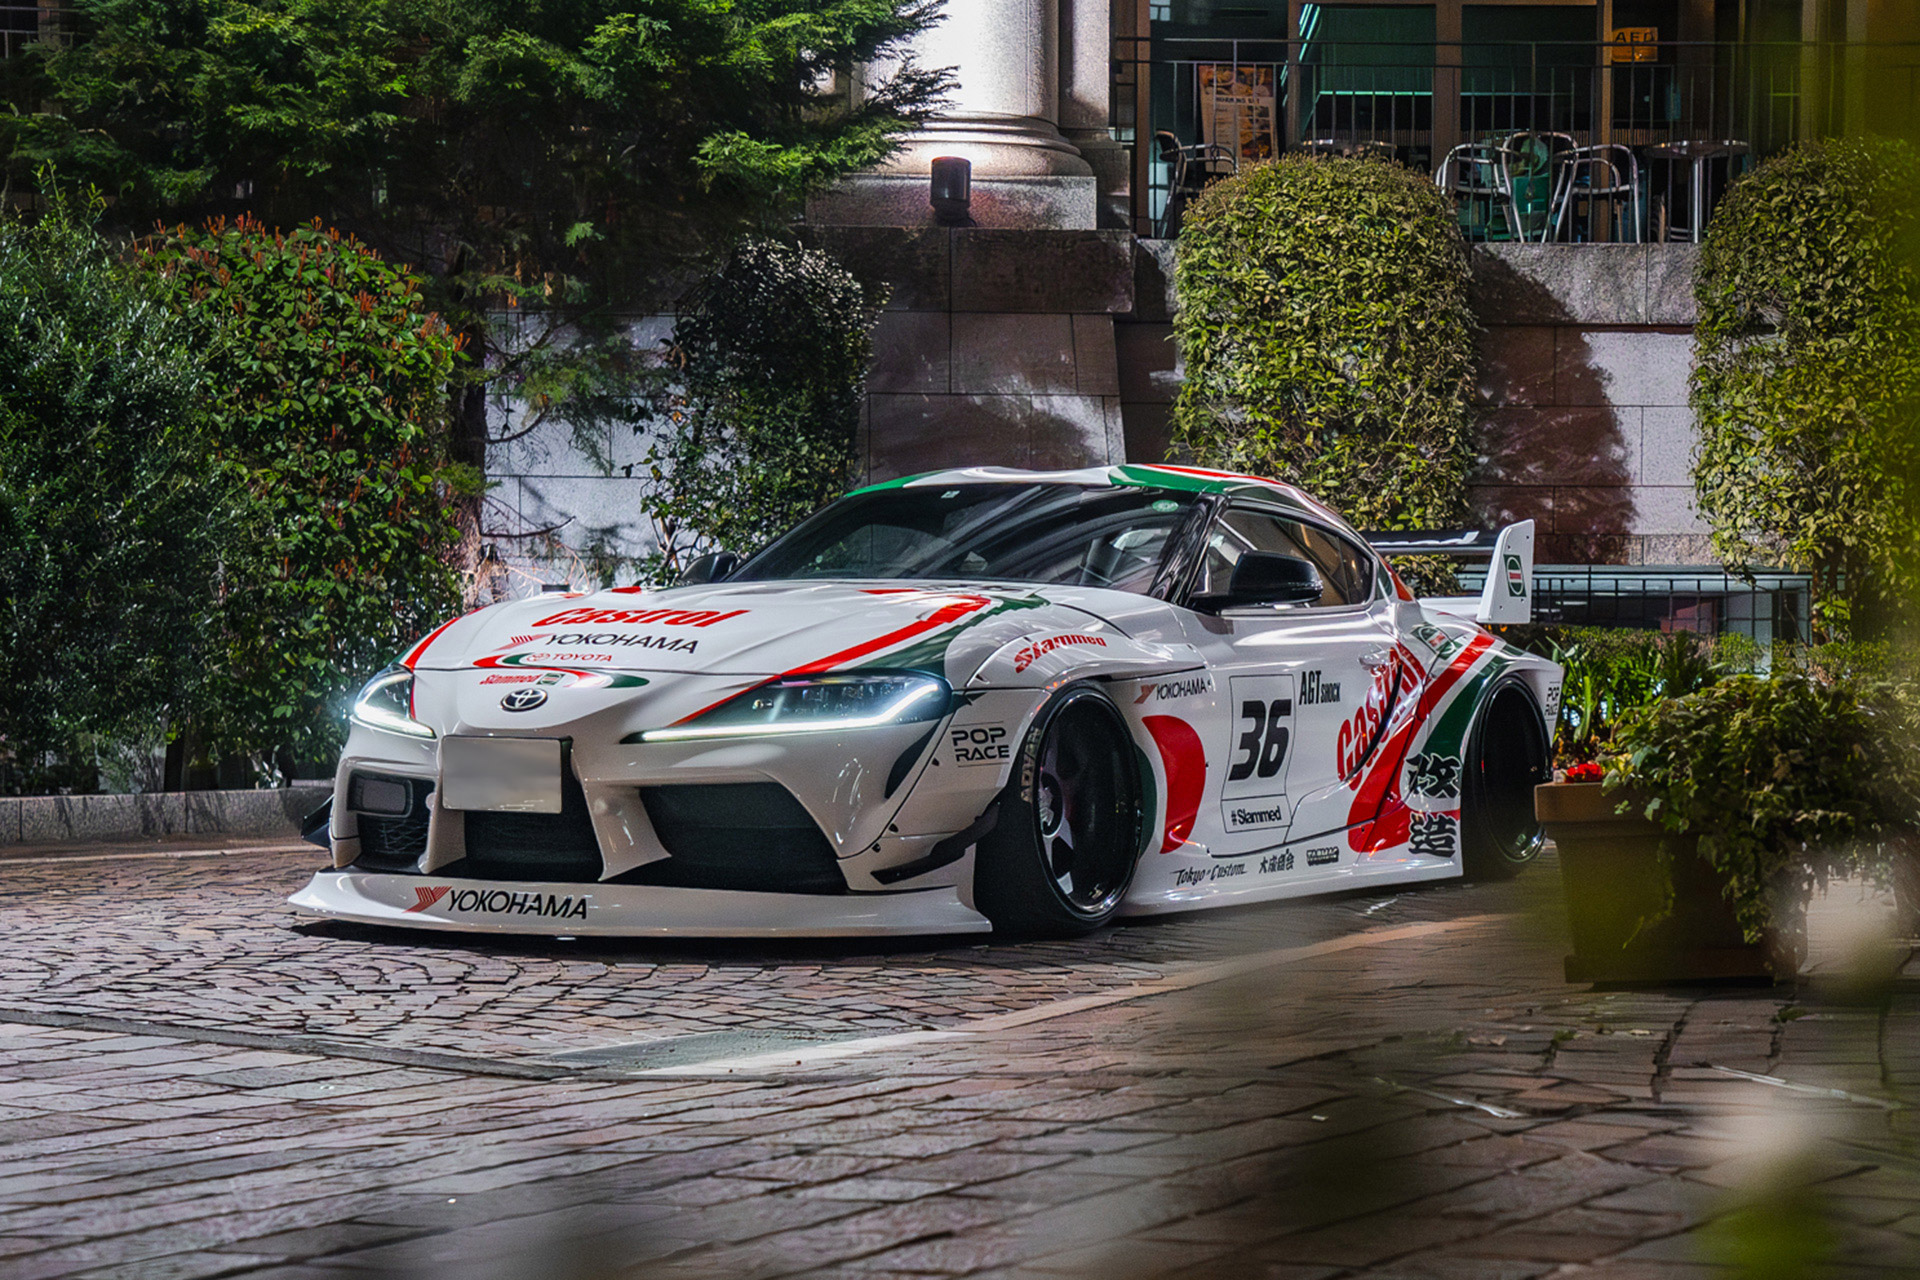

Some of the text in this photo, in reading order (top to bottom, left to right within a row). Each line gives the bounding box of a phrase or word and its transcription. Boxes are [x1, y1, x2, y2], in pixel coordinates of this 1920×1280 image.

[1614, 31, 1656, 43] AED
[531, 607, 751, 628] Castrol
[545, 633, 699, 654] YOKOHAMA
[1014, 632, 1108, 674] Slammed
[552, 653, 613, 662] TOYOTA
[1155, 677, 1207, 701] YOKOHAMA
[1299, 670, 1341, 706] AGT SHOCK
[951, 727, 1007, 748] POP
[1228, 699, 1293, 781] 36
[954, 744, 1010, 763] RACE
[1231, 805, 1282, 826] #Slammed
[448, 889, 588, 920] YOKOHAMA
